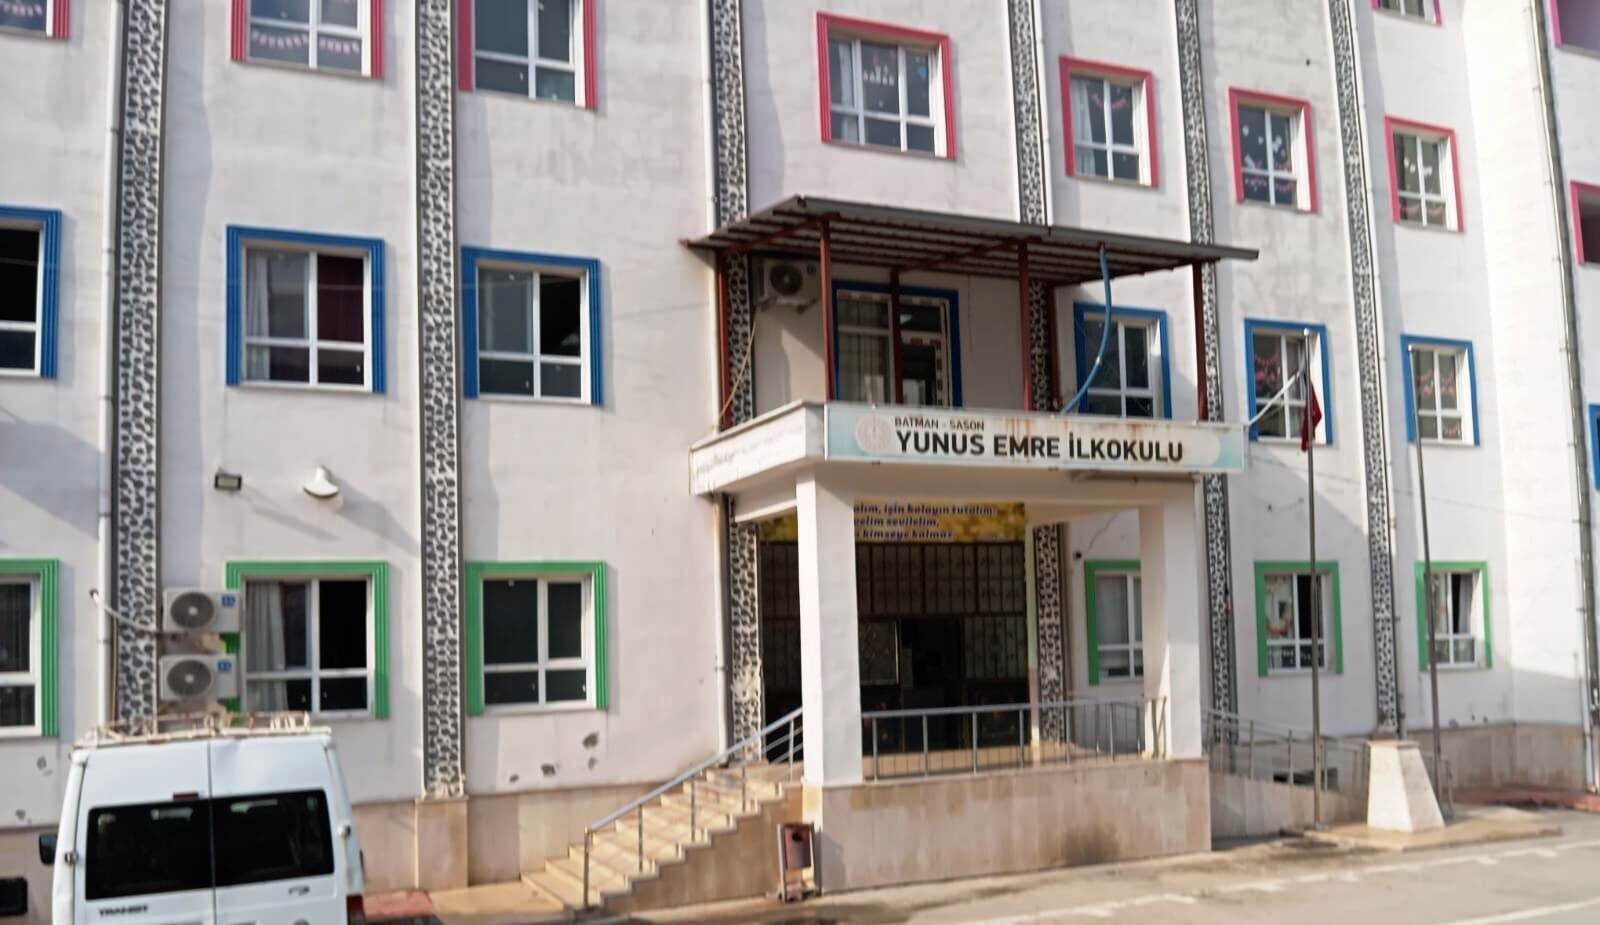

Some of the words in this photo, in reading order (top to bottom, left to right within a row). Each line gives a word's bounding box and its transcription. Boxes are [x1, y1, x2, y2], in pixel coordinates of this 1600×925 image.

[895, 416, 939, 429] BATMAN
[950, 419, 984, 432] SASON
[896, 430, 985, 455] YUNUS
[993, 434, 1060, 458] EMRE
[1069, 432, 1183, 462] İLKOKULU
